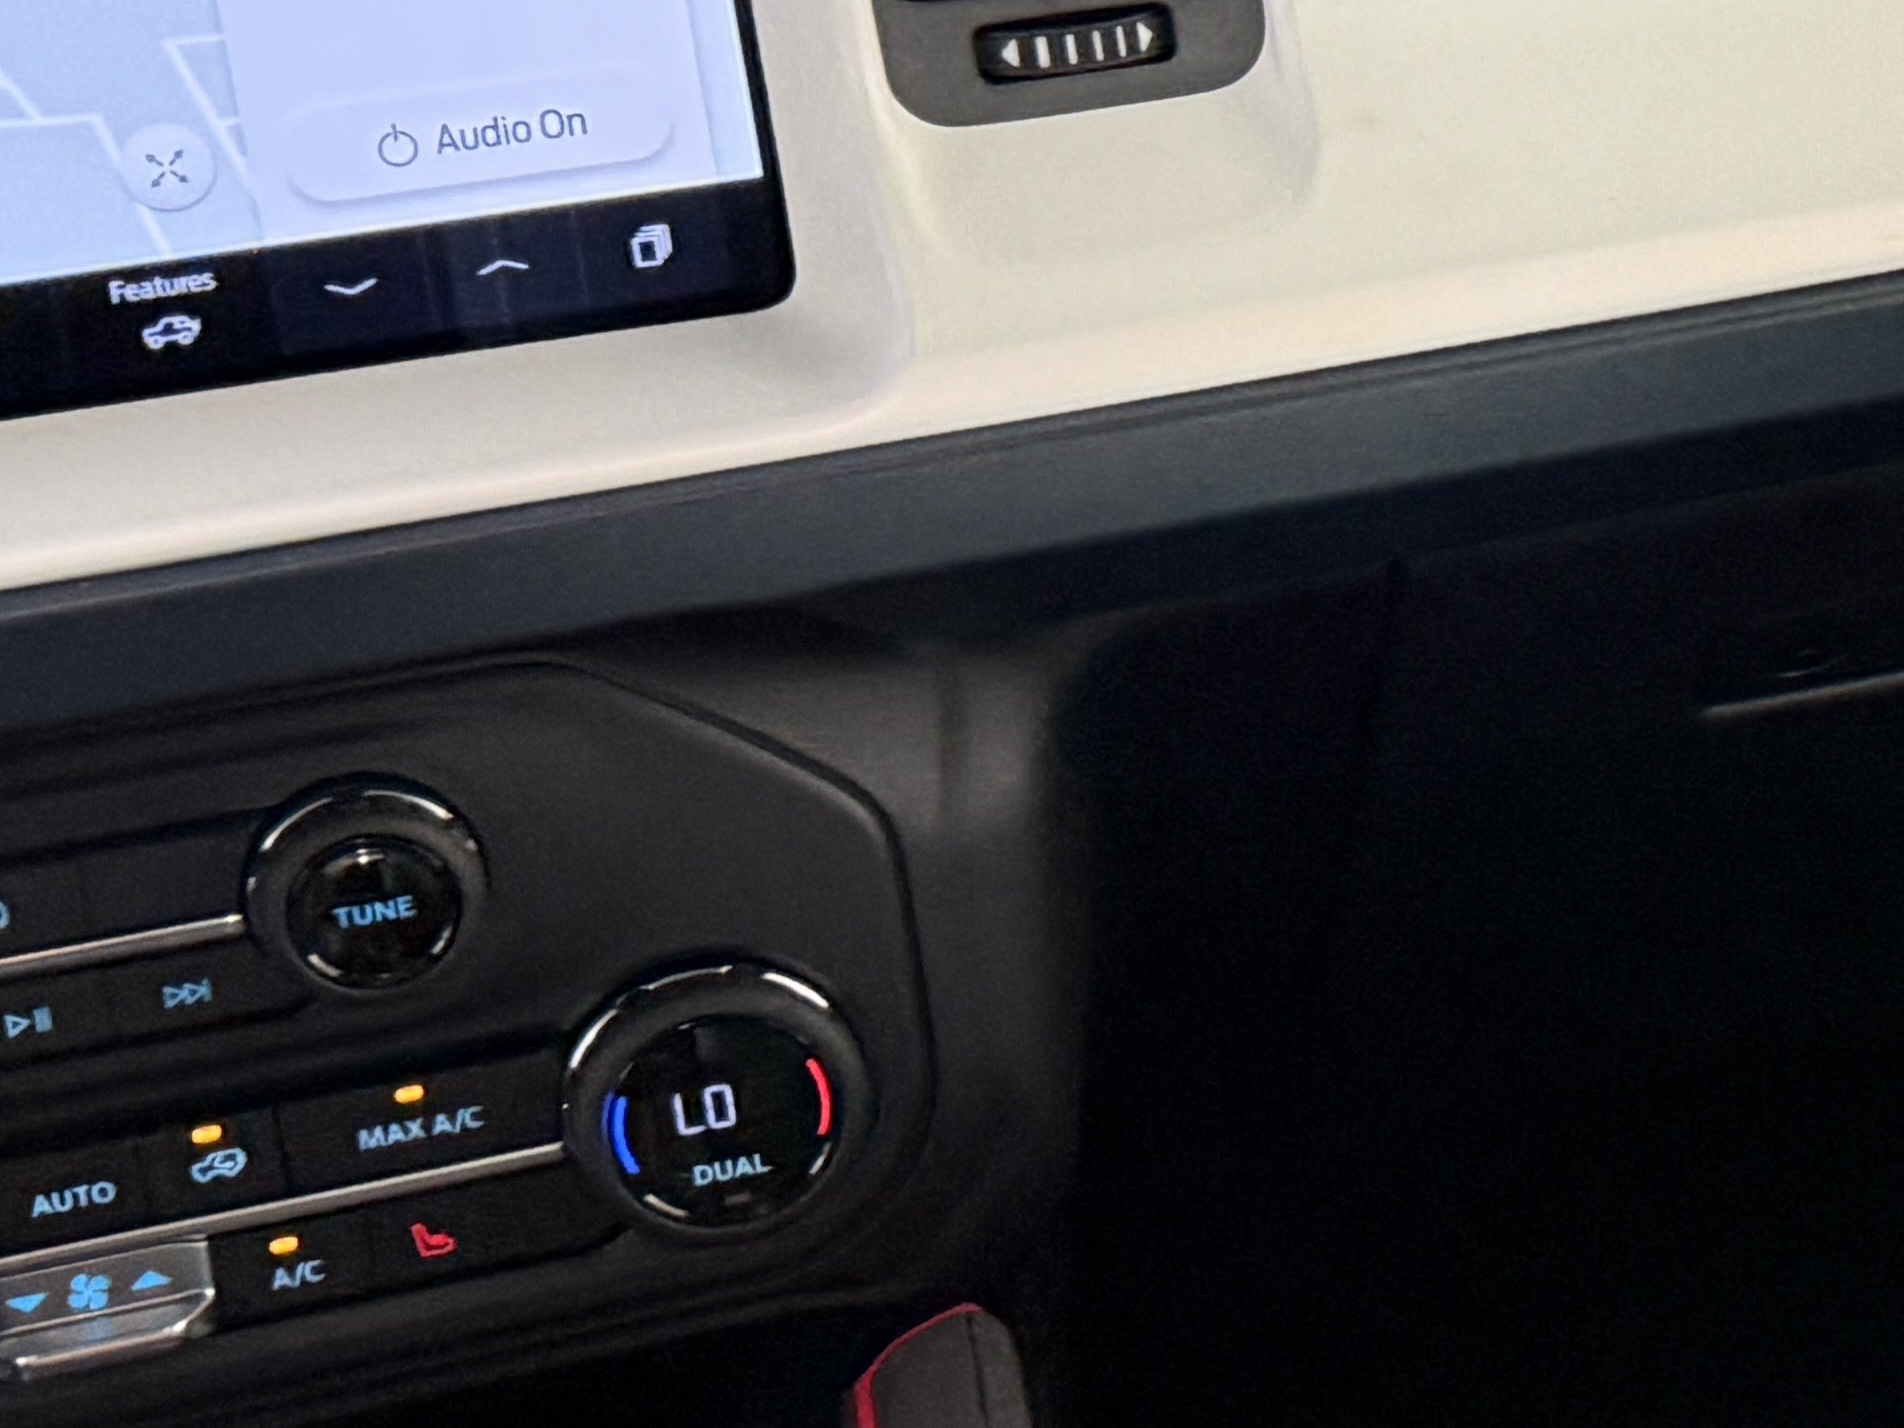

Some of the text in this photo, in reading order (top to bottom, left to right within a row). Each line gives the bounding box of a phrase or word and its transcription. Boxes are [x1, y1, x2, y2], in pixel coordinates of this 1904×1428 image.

[436, 108, 588, 155] Audio On
[108, 270, 220, 305] Features
[331, 894, 418, 929] TUNE
[356, 1104, 485, 1152] MAX A/C
[669, 1082, 738, 1137] LO
[692, 1152, 773, 1188] DUAL
[31, 1180, 118, 1219] AUTO
[271, 1259, 327, 1292] A/C
